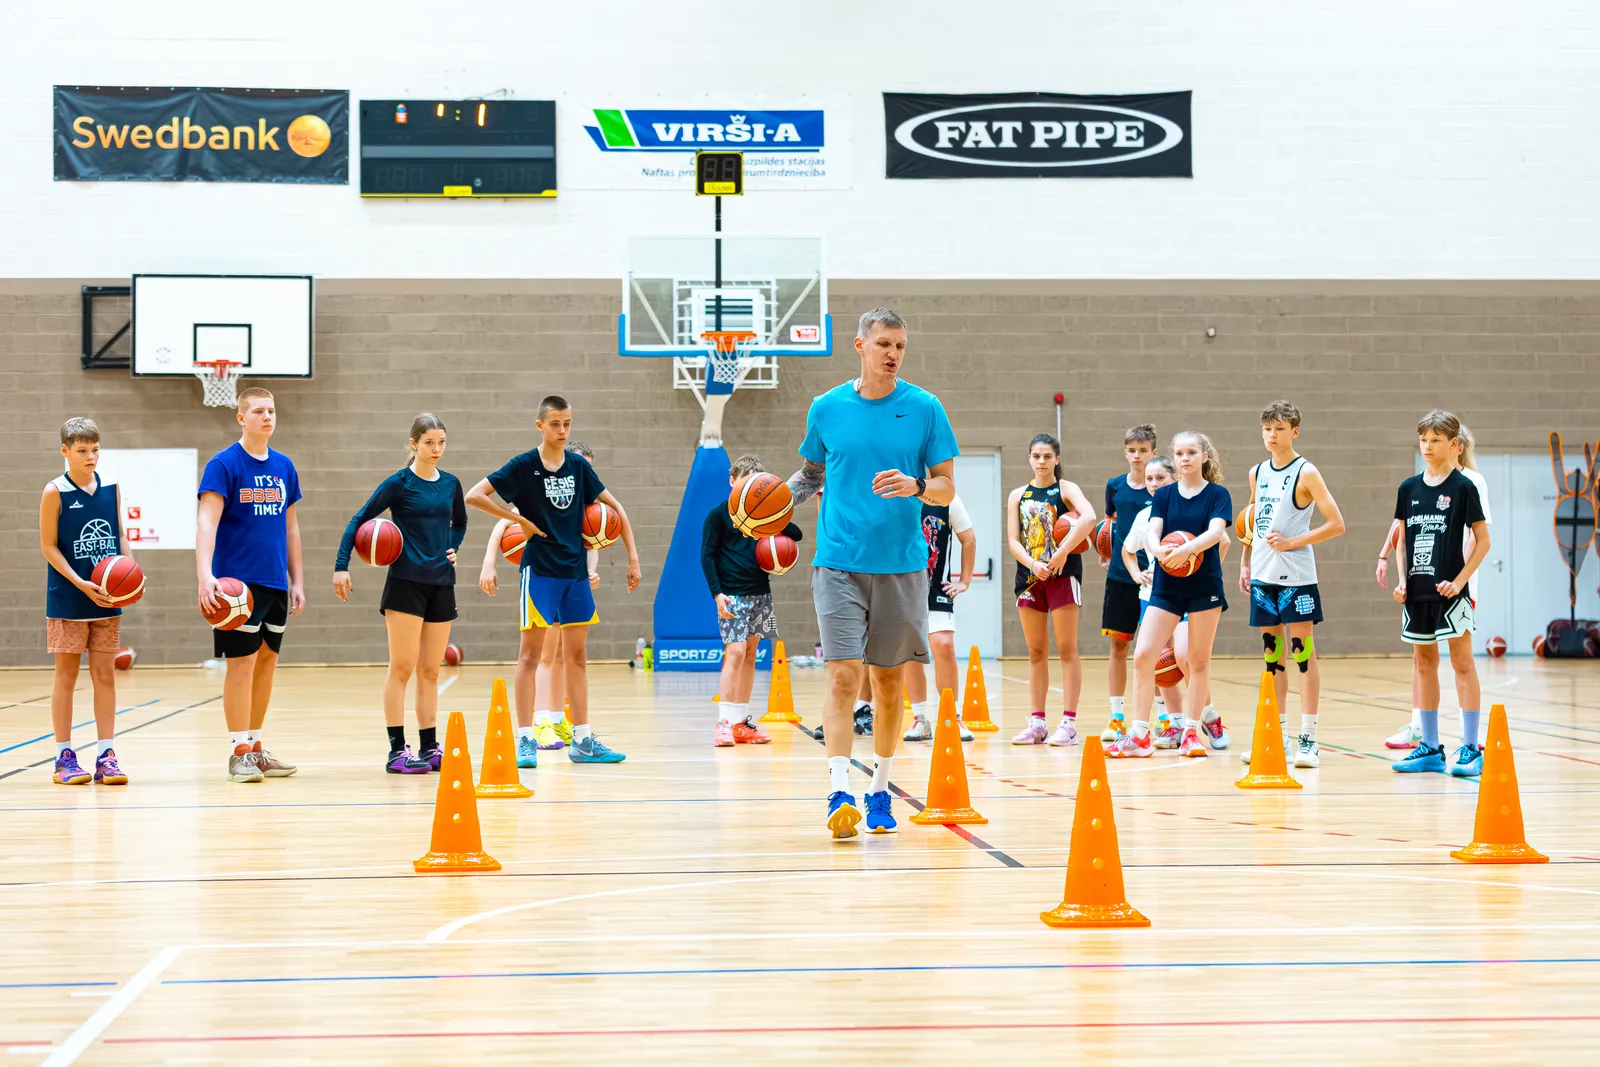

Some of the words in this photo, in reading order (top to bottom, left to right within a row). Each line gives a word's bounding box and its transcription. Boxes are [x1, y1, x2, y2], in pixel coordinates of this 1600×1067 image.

[72, 115, 281, 152] Swedbank
[652, 114, 802, 143] VIRŠI-A
[934, 120, 1023, 148] FAT
[1030, 120, 1145, 148] PIPE
[641, 168, 675, 177] Naftas
[253, 503, 278, 516] TIME
[659, 649, 768, 661] SPORTSYM
